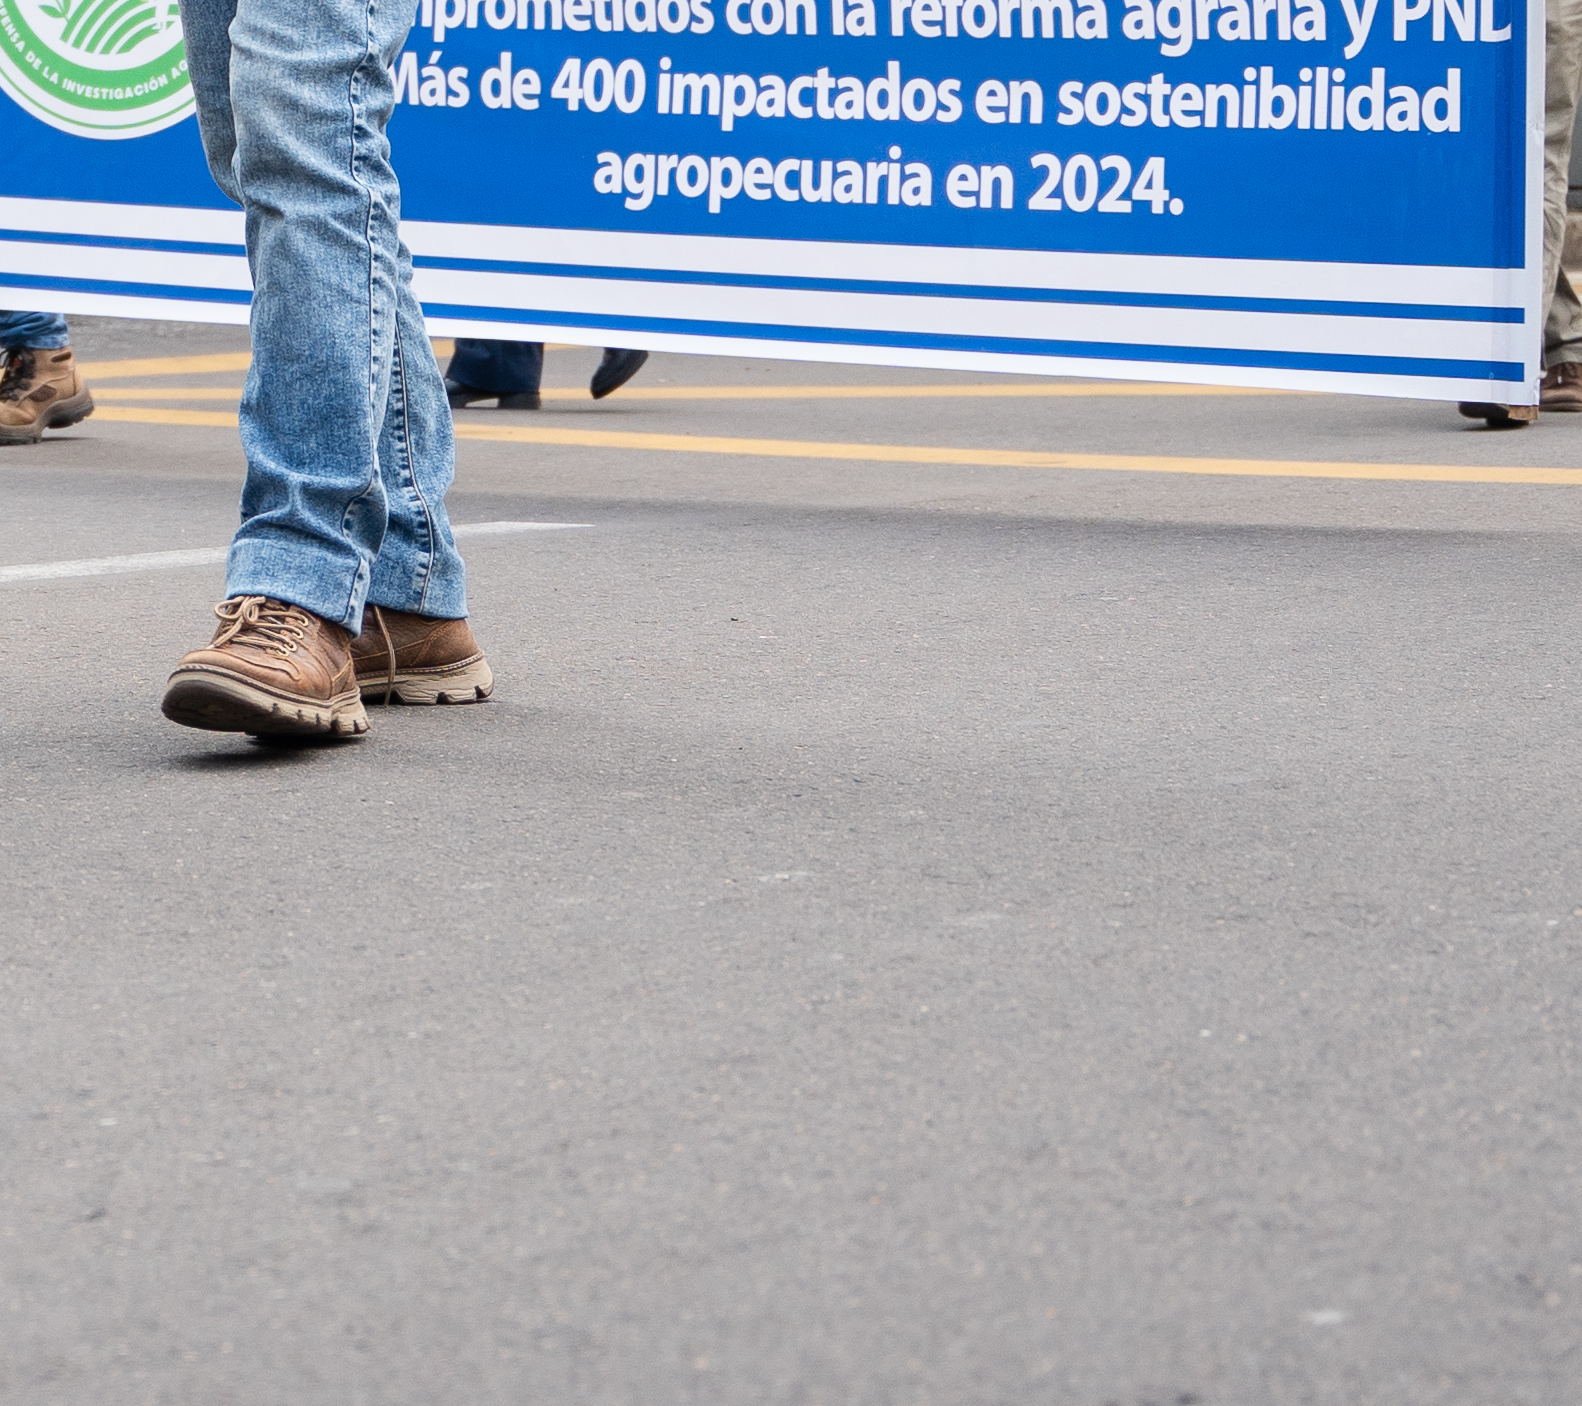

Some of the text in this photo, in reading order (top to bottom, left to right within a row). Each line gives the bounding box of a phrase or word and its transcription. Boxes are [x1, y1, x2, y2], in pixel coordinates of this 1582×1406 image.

[25, 51, 43, 71] DE
[42, 66, 59, 85] LA
[62, 77, 169, 101] INVESTIGACIÓN
[390, 50, 1461, 132] Más de 400 impactados en sostenibilidad
[594, 146, 1183, 215] agropecuaria en 2024.
